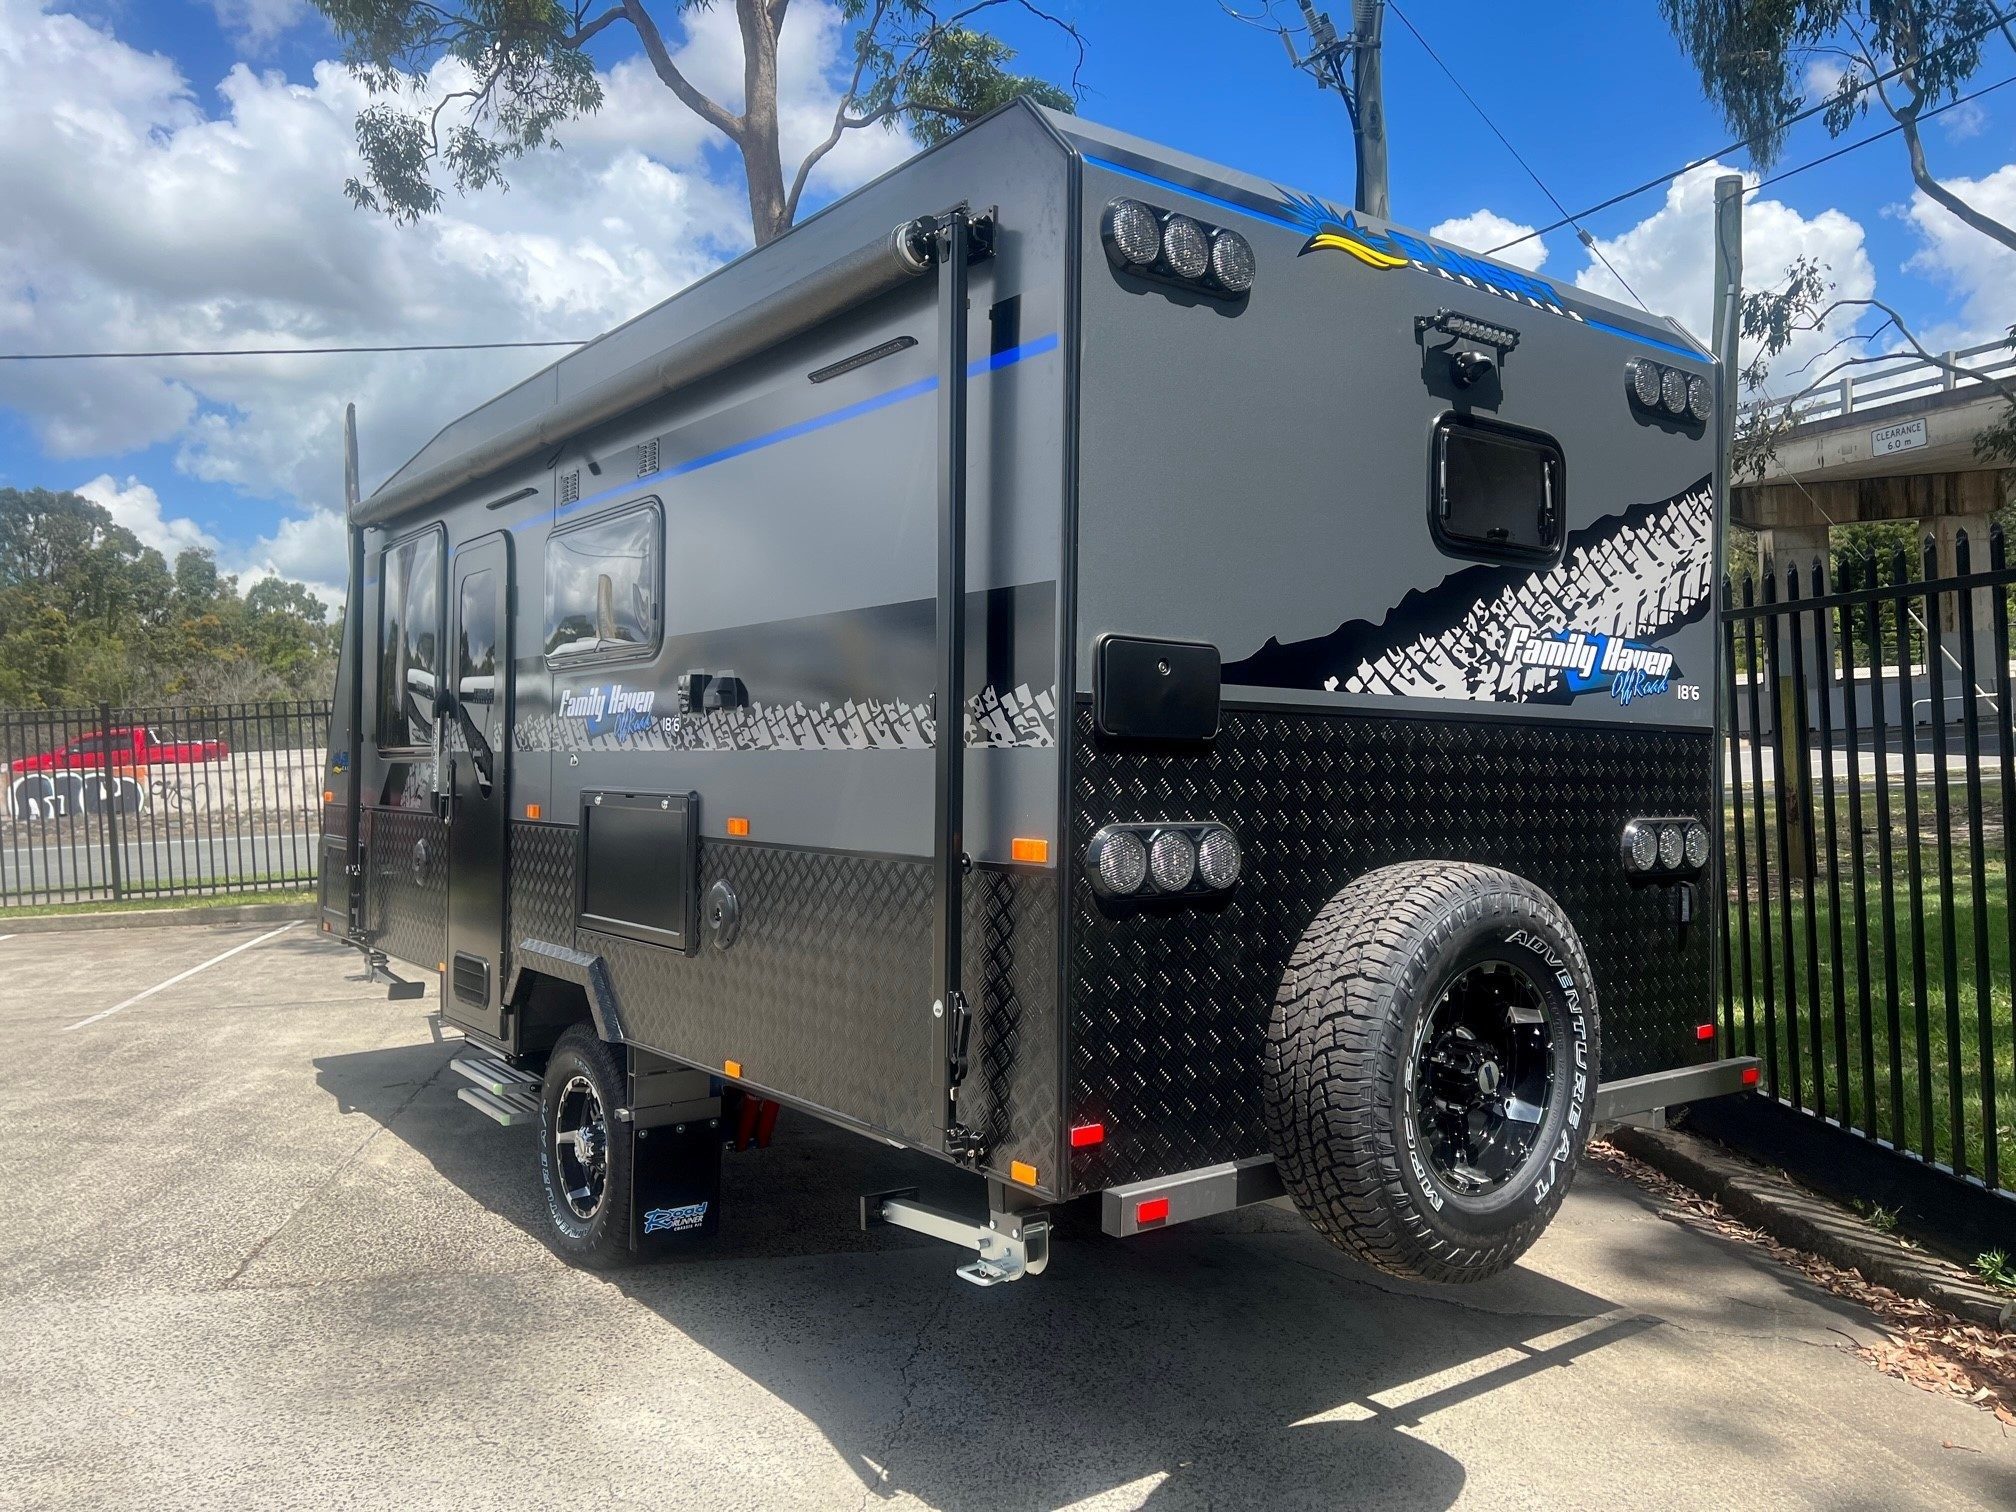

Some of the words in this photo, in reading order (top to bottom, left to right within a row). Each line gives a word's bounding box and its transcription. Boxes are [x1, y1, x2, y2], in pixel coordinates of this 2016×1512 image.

[1412, 259, 1584, 322] CARAVANS
[1876, 422, 1922, 441] CLEARANCE
[1504, 626, 1598, 678] Family
[1601, 637, 1673, 676] Haven
[559, 687, 606, 722] Family
[607, 685, 655, 714] Haven
[1504, 929, 1588, 1130] ADVENTURE
[1534, 1129, 1570, 1205] A/T
[644, 1201, 708, 1234] Road
[672, 1215, 704, 1227] RUNNER
